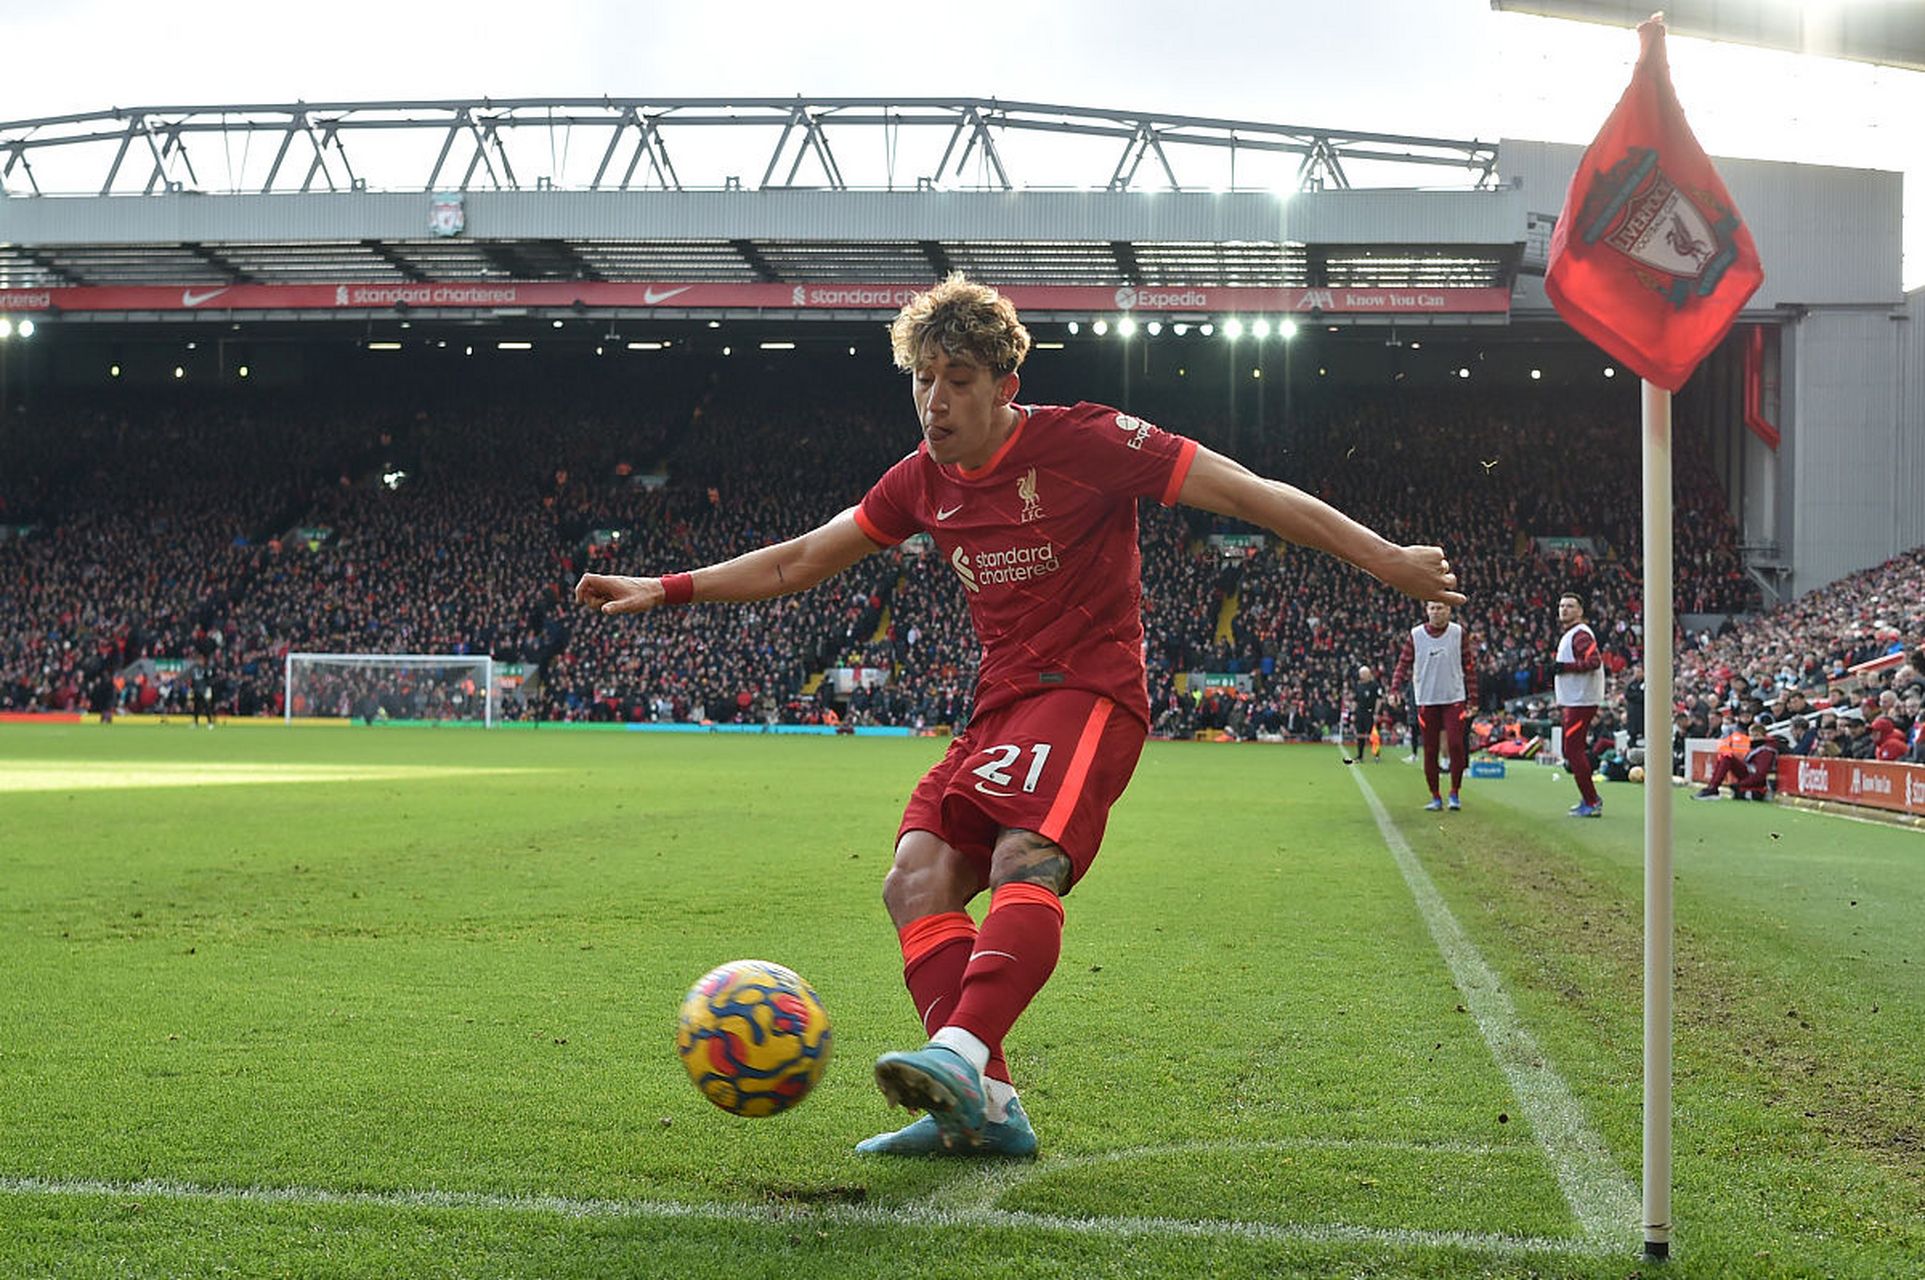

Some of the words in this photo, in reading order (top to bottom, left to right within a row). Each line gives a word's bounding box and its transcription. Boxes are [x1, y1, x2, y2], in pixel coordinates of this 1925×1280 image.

[354, 288, 431, 303] standard
[434, 288, 516, 301] chartered
[810, 289, 890, 304] standard
[1138, 291, 1207, 308] Expedia
[1296, 289, 1334, 309] AXA
[1346, 294, 1384, 306] Know
[1390, 294, 1414, 306] You
[1417, 294, 1444, 307] Can
[975, 542, 1053, 569] standard
[979, 556, 1060, 585] chartered
[972, 743, 1051, 793] 21
